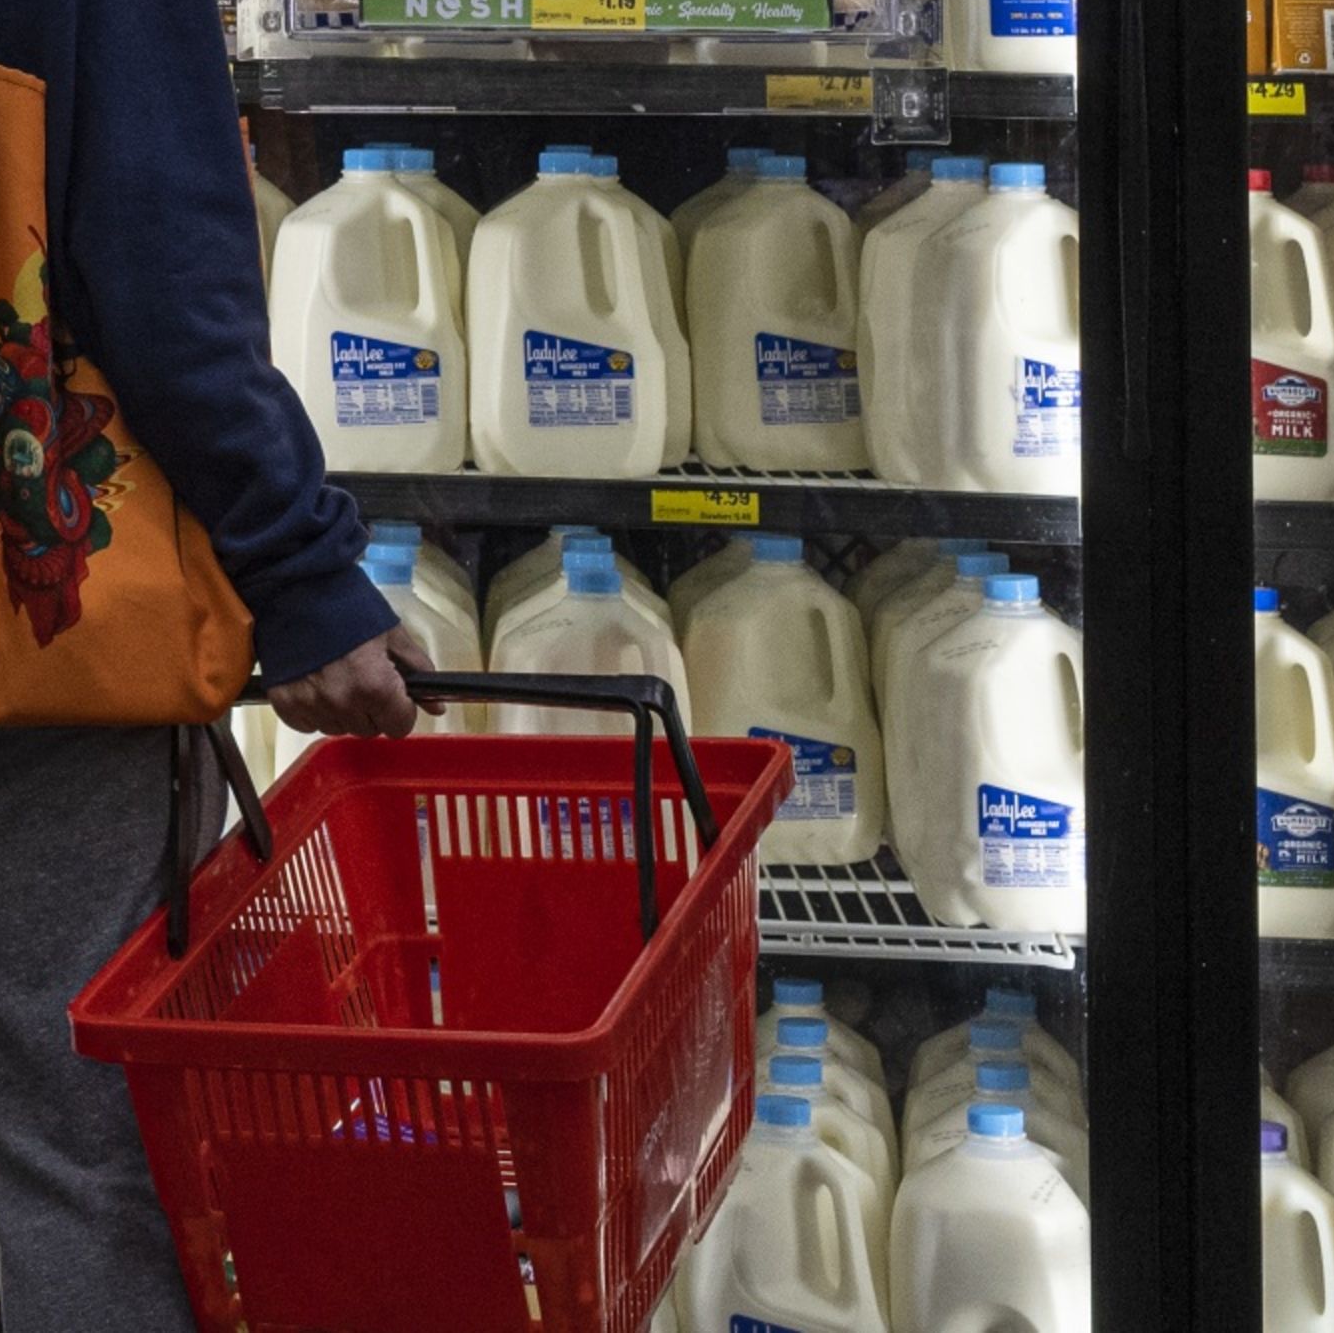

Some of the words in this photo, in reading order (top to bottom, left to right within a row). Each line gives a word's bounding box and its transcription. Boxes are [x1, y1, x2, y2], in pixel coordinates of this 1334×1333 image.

[678, 3, 736, 21] Specialty
[750, 3, 804, 21] Healthy
[333, 338, 385, 376] LadyLee
[526, 338, 578, 375] LadyLee
[757, 340, 809, 374] LadyLee
[1273, 410, 1312, 419] ORGANIC
[1272, 424, 1313, 439] MILK
[982, 793, 1036, 833] LadyLee
[1283, 841, 1322, 850] ORGANIC
[1296, 853, 1328, 864] MILK
